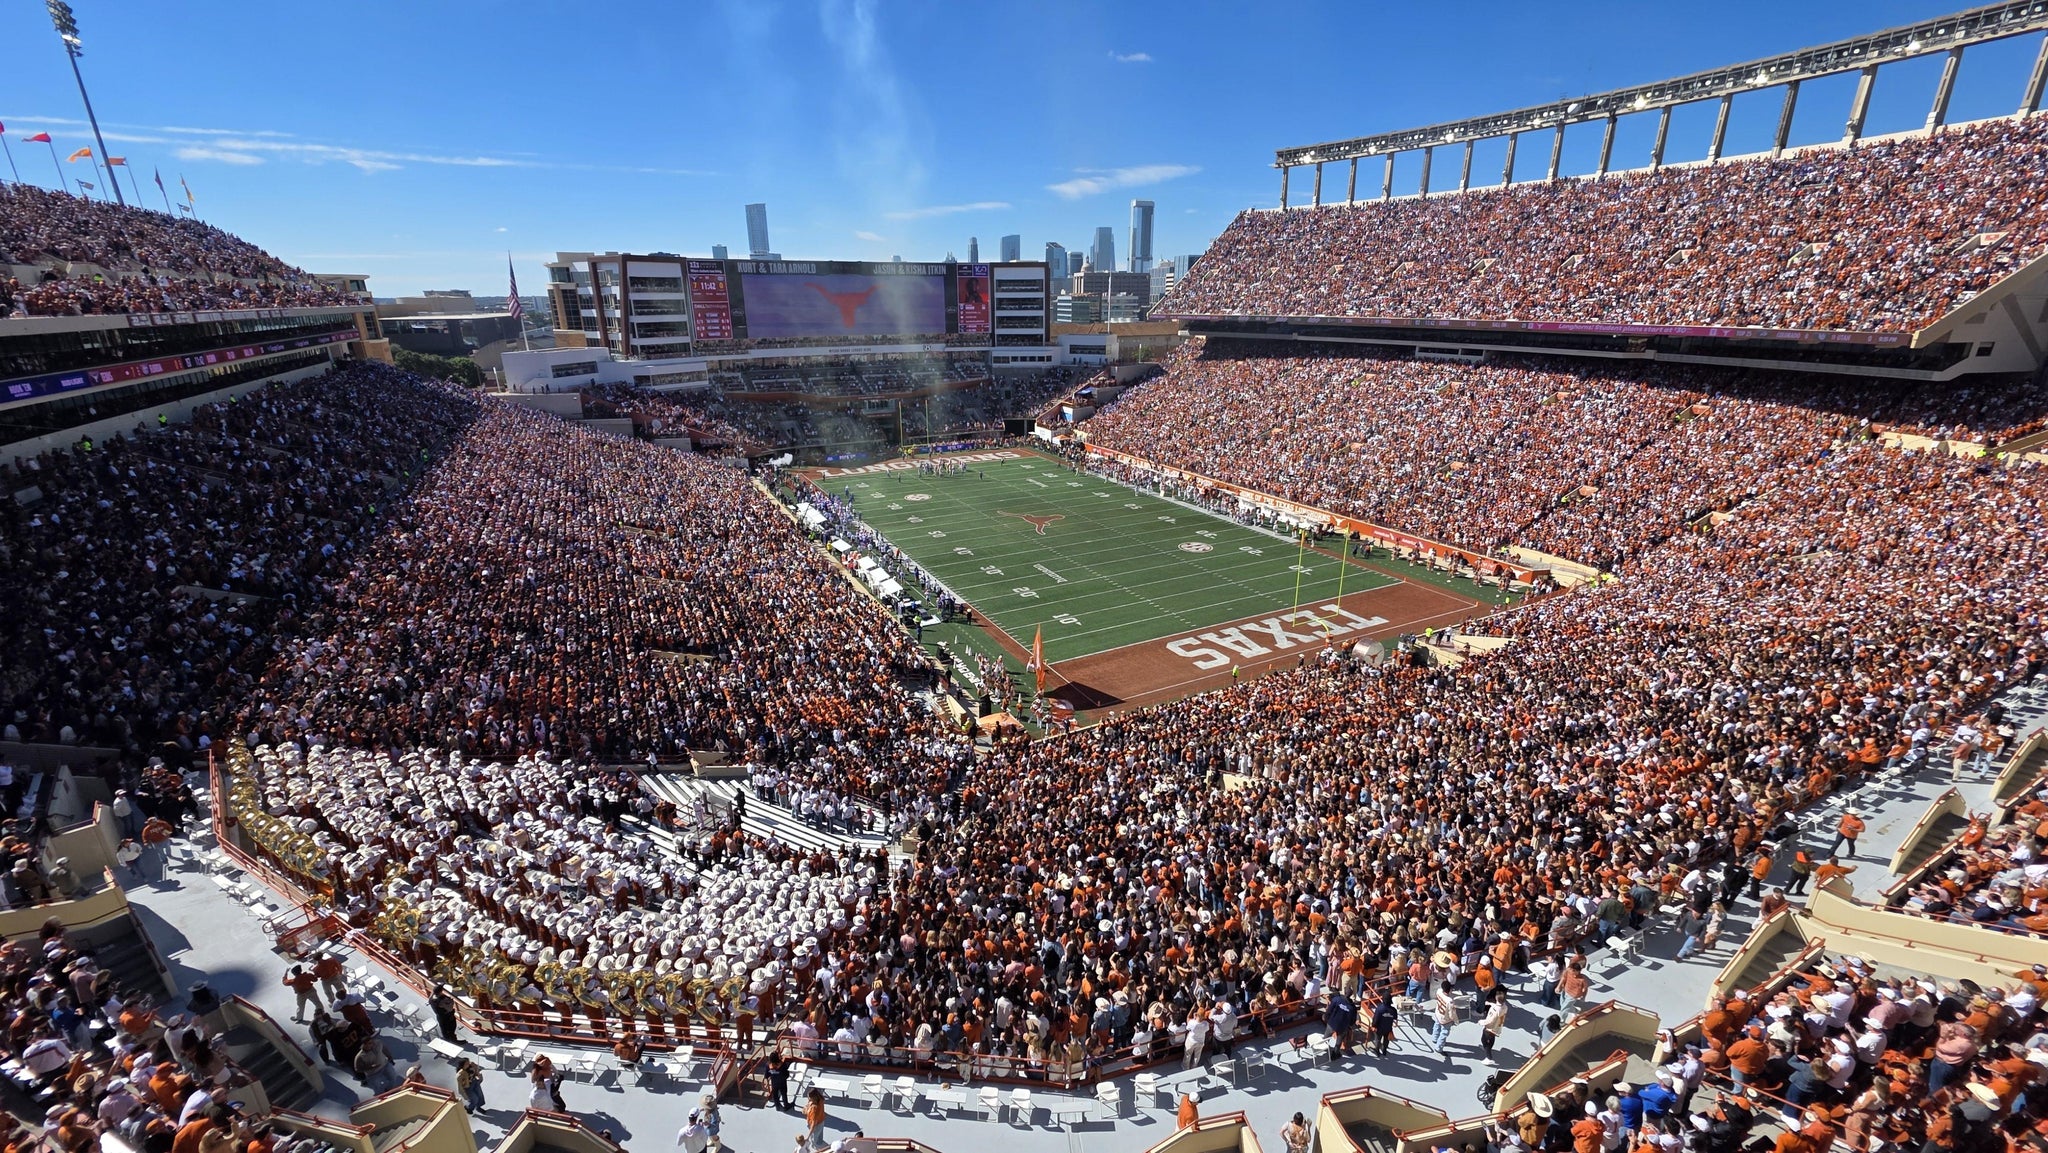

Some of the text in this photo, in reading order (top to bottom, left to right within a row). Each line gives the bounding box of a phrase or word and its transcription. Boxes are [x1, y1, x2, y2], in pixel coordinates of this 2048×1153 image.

[737, 262, 757, 274] KURT
[758, 262, 767, 274] &
[768, 262, 787, 274] TARA
[788, 263, 817, 274] ARNOLD
[873, 264, 947, 275] JASON & KISHA ITKIN
[700, 282, 717, 290] 11:42
[1276, 500, 1294, 511] TEXAS
[980, 564, 1002, 575] 30
[1012, 586, 1036, 598] 20
[1052, 613, 1079, 625] 10
[1166, 603, 1390, 670] TEXAS
